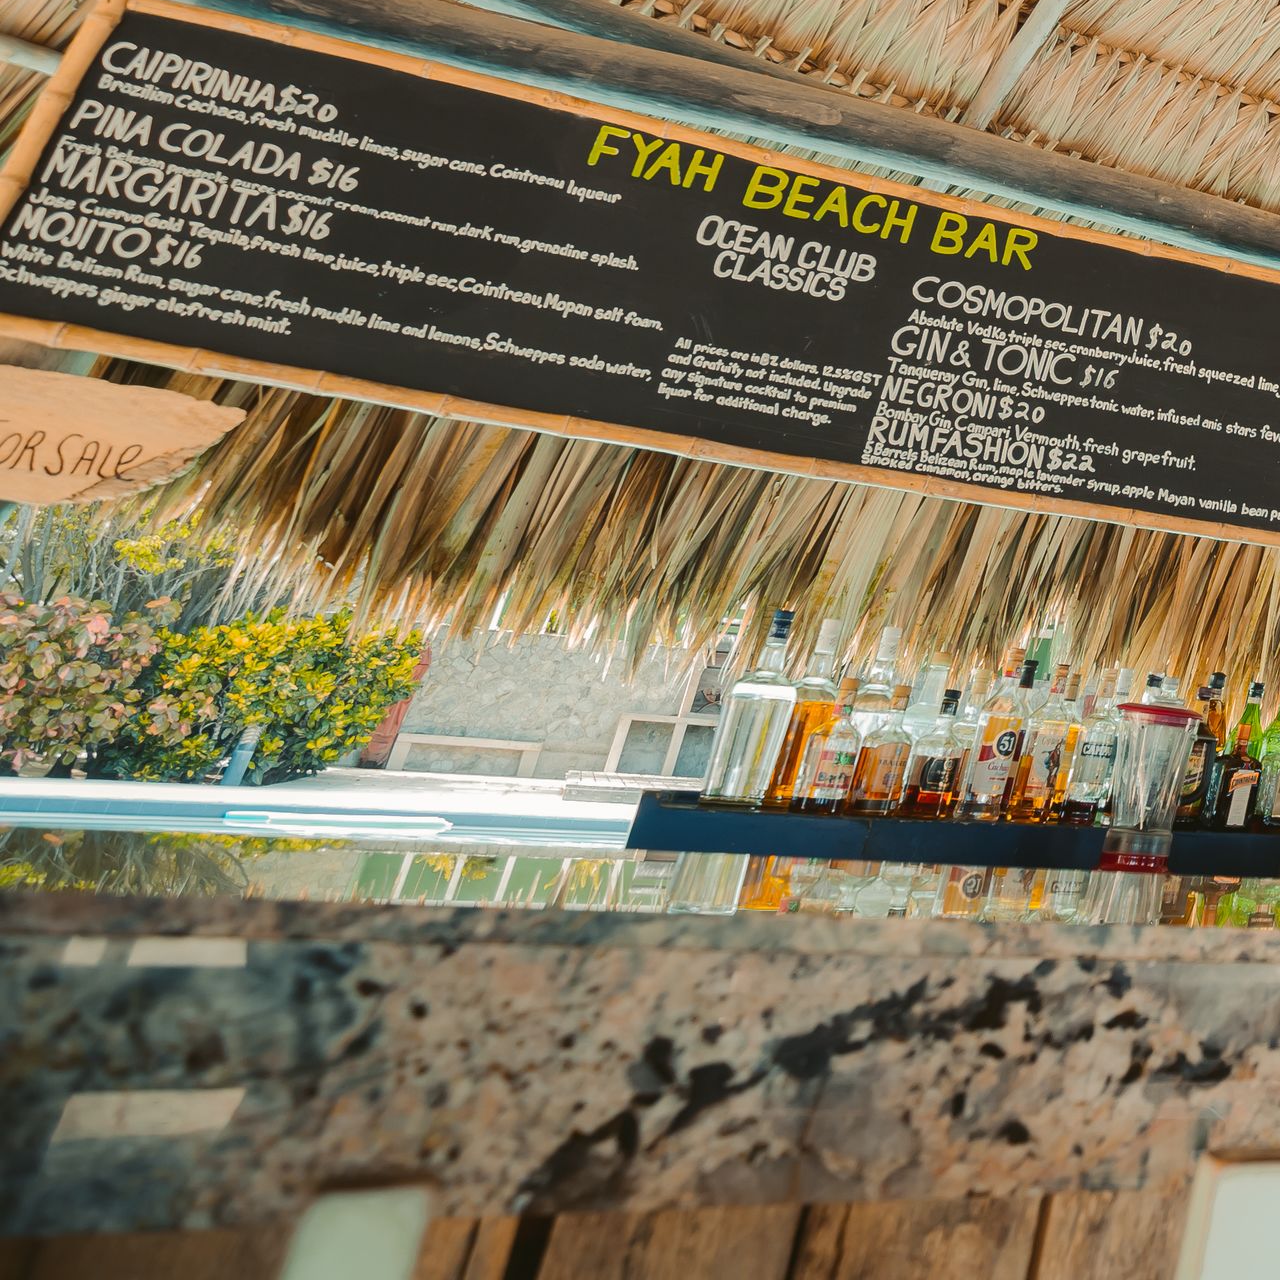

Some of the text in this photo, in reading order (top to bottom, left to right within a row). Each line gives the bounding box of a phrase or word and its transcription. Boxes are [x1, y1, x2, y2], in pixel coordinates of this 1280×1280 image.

[101, 41, 339, 123] CAIPIRINHA $20
[69, 99, 361, 193] PINA COLADA $16
[28, 187, 77, 211] Jose
[40, 152, 340, 241] MARGARITA $16
[489, 163, 566, 190] Cointreau
[566, 179, 623, 204] liqueur
[587, 124, 1039, 271] FYAH BEACH BAR
[9, 203, 213, 269] MOJITO $16
[695, 214, 877, 282] OCEAN CLUB
[1, 240, 55, 266] White
[401, 323, 429, 339] and
[713, 249, 854, 302] CLASSICS
[907, 308, 964, 332] Absolute
[1197, 367, 1256, 389] squeezed
[912, 275, 1193, 357] COSMOPOLITAN $20
[667, 353, 873, 400] and Gratuity not included. Upgrade
[674, 336, 820, 375] All prices are dollars.
[890, 324, 1120, 390] GIN & TONIC $16
[657, 381, 832, 427] liquor for additional charge.
[661, 367, 687, 384] any
[686, 370, 743, 392] signature
[792, 390, 808, 404] to
[808, 396, 857, 413] premium
[880, 374, 1046, 424] NEGRONI $20
[887, 356, 961, 389] Tanqueray
[1201, 418, 1223, 432] anis
[1225, 421, 1257, 438] stars
[0, 430, 47, 473] OR
[875, 400, 929, 425] Bombay
[1121, 448, 1196, 471] grapefruit.
[1046, 444, 1096, 473] $22
[919, 448, 968, 470] Belizean
[1033, 469, 1086, 487] lavender
[1157, 487, 1196, 507] Mayan
[1198, 498, 1238, 514] vanilla
[1240, 502, 1269, 519] bean
[1016, 477, 1064, 494] bitters.
[998, 729, 1015, 754] 51
